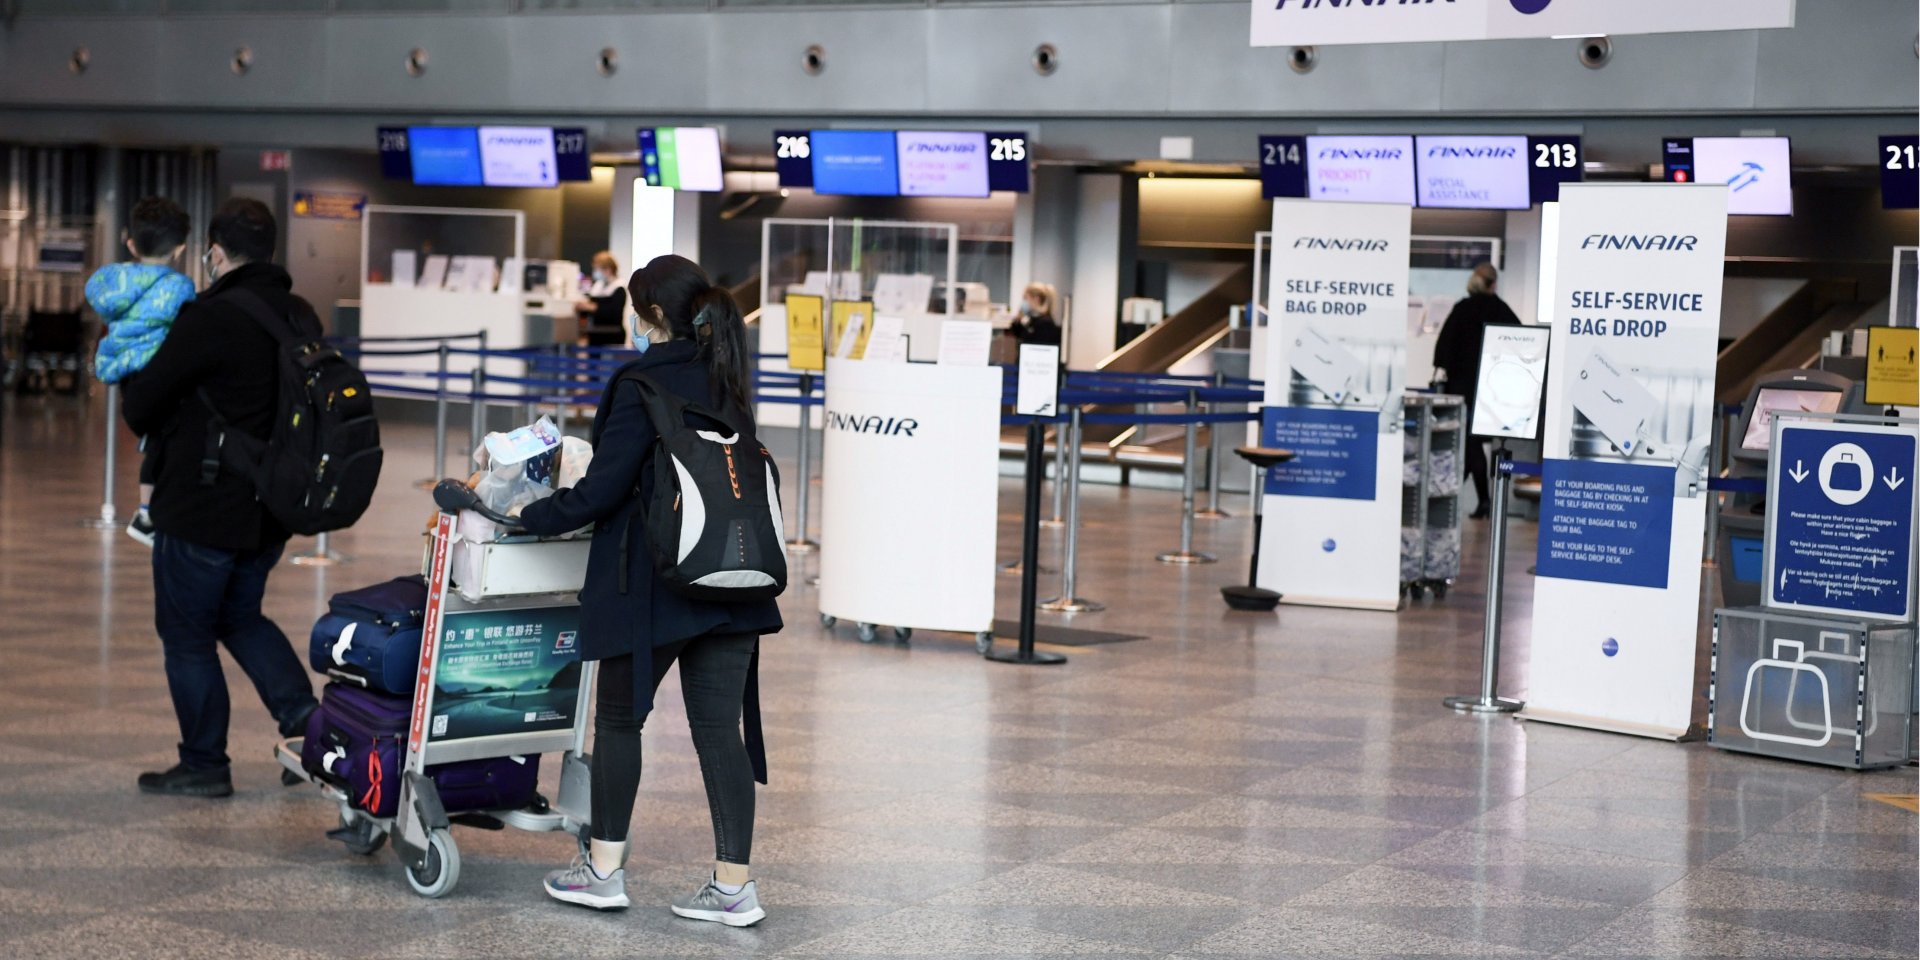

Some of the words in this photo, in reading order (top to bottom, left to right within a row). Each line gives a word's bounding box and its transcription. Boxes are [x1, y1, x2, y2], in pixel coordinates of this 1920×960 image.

[556, 134, 584, 154] 217
[777, 136, 810, 159] 216
[990, 138, 1025, 161] 215
[1263, 144, 1300, 165] 214
[1318, 147, 1402, 160] FINNAIR
[1428, 146, 1516, 159] FINNAIR
[1535, 143, 1577, 168] 213
[1886, 145, 1920, 170] 21
[1293, 236, 1389, 252] FINNAIR
[1581, 234, 1698, 251] FINNAIR
[1286, 280, 1395, 297] SELF-SERVICE
[1285, 300, 1317, 314] BAG
[1322, 301, 1367, 316] DROP
[1571, 291, 1703, 312] SELF-SERVICE
[1570, 318, 1607, 336] BAG
[1613, 319, 1667, 338] DROP
[826, 410, 919, 438] FINNAIR
[1555, 480, 1566, 488] GET
[1568, 481, 1583, 489] YOUR
[1585, 482, 1614, 491] BOARDING
[1616, 484, 1630, 492] PASS
[1632, 485, 1644, 493] AND
[1555, 490, 1581, 499] BAGGAGE
[1583, 491, 1593, 499] TAG
[1595, 492, 1602, 500] BY
[1604, 493, 1632, 503] CHECKING
[1634, 495, 1640, 503] IN
[1641, 496, 1648, 504] AT
[1554, 499, 1564, 507] THE
[1567, 500, 1605, 510] SELF-SERVICE
[1606, 503, 1625, 512] KIOSK.
[1553, 516, 1574, 524] ATTACH
[1576, 517, 1586, 525] THE
[1588, 518, 1615, 528] BAGGAGE
[1617, 520, 1627, 528] TAG
[1629, 521, 1637, 529] TO
[1553, 525, 1568, 533] YOUR
[1569, 526, 1582, 534] BAG.
[1871, 518, 1892, 526] baggage
[1567, 542, 1582, 551] YOUR
[1584, 544, 1595, 552] BAG
[1598, 544, 1605, 552] TO
[1607, 545, 1617, 553] THE
[1551, 551, 1573, 560] SERVICE
[1575, 553, 1587, 561] BAG
[1589, 554, 1604, 562] DROP
[1606, 556, 1622, 564] DESK.
[446, 629, 456, 642] 约
